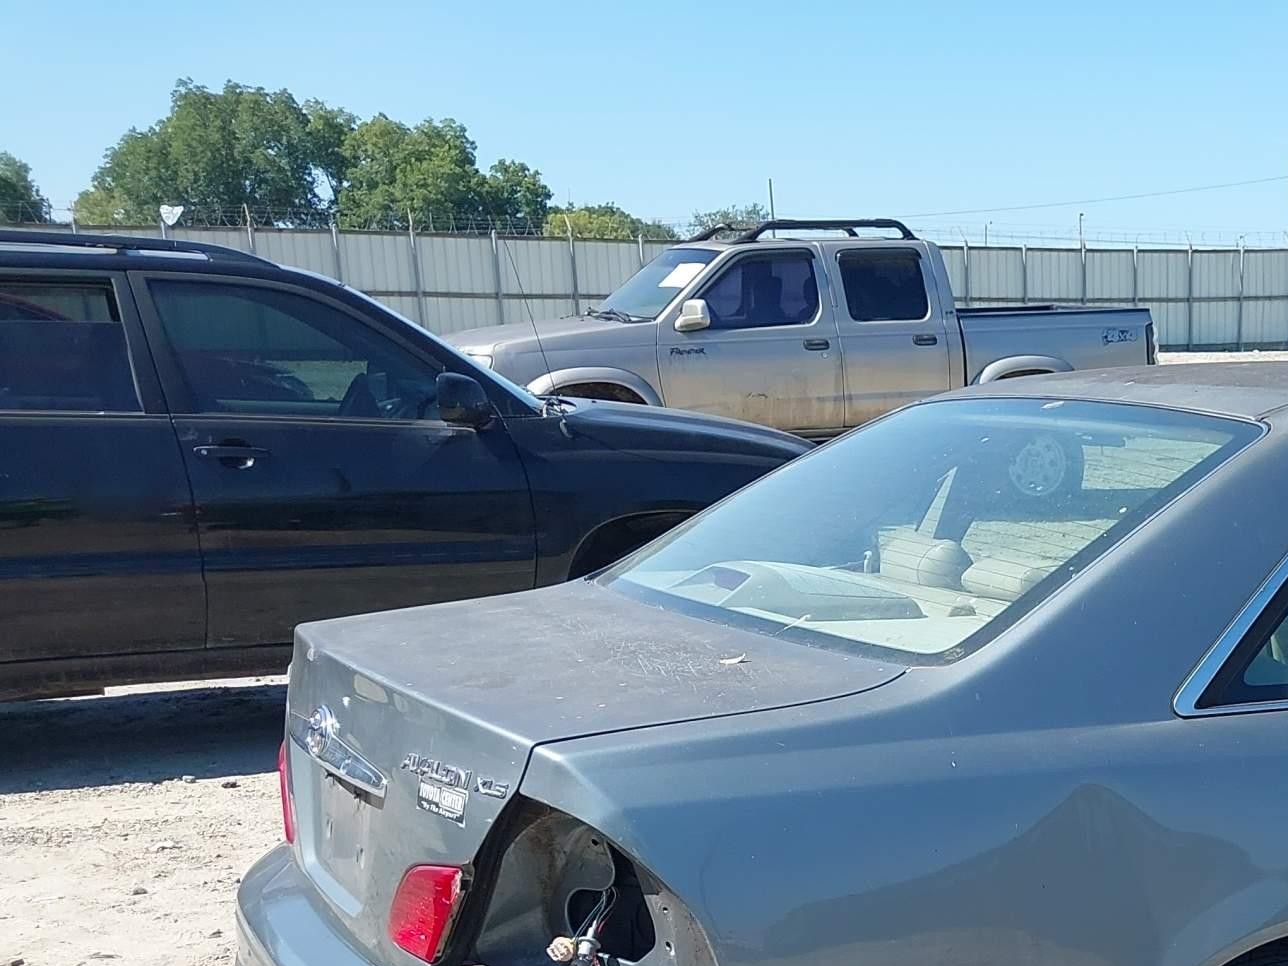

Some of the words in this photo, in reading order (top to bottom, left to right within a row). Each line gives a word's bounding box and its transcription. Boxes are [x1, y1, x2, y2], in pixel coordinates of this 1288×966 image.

[400, 753, 472, 790] AVALON
[474, 777, 510, 799] XLS
[419, 782, 440, 803] TOYOTA
[441, 790, 464, 811] CENTER
